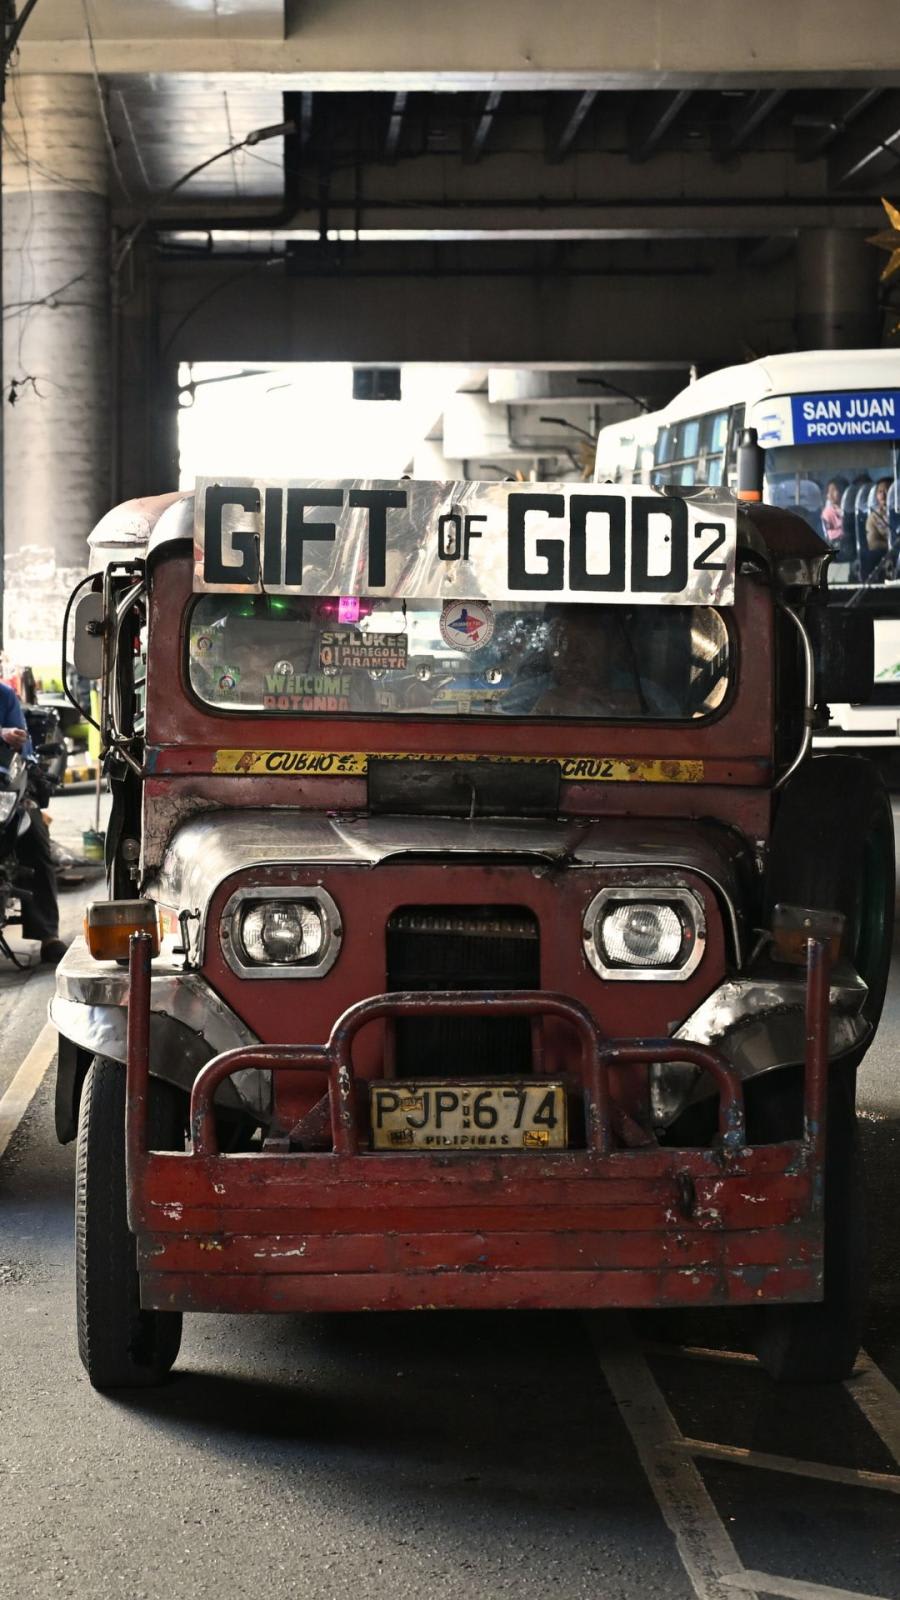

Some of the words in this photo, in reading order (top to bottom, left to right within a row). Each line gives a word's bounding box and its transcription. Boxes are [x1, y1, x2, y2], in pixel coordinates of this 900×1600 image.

[803, 400, 841, 420] SAN
[846, 398, 895, 418] JUAN
[807, 420, 895, 437] PROVINCIAL
[203, 486, 407, 587] GIFT
[438, 514, 488, 561] OF
[507, 492, 689, 593] GOD
[693, 522, 727, 570] 2
[350, 632, 406, 647] LUKES
[265, 673, 352, 695] WELCOME
[263, 695, 351, 711] ROTONDA
[265, 751, 338, 772] CUBAO
[561, 759, 614, 778] CRUZ
[473, 1091, 558, 1129] 674
[425, 1134, 510, 1146] PILIPINAS
